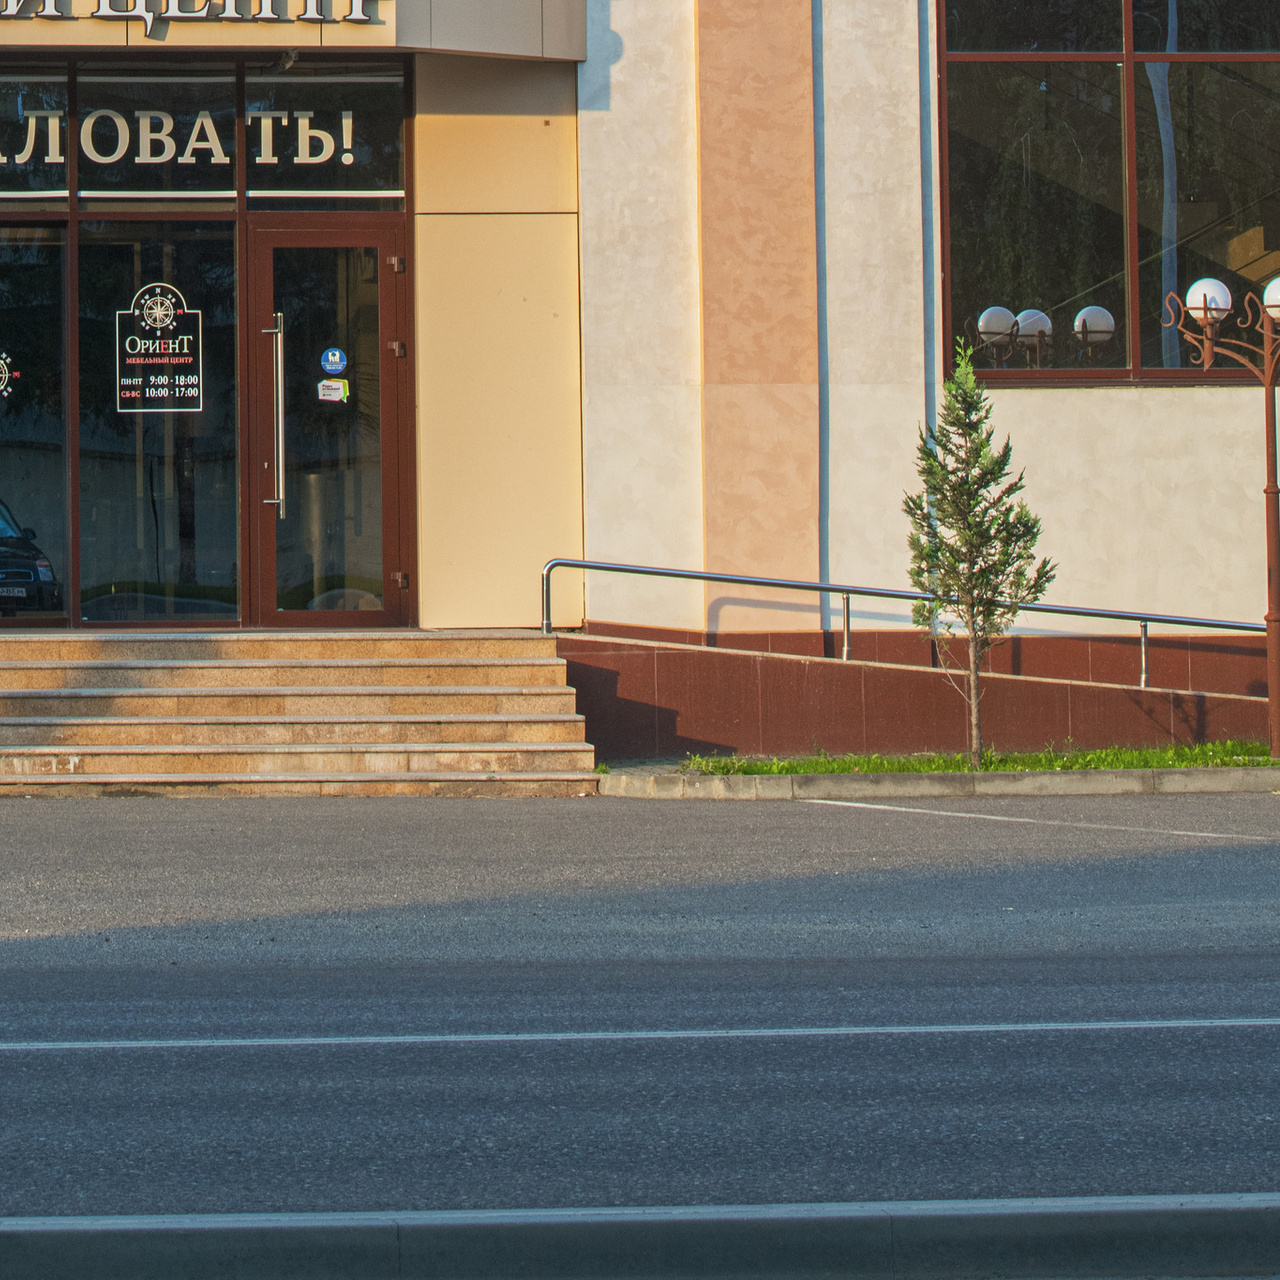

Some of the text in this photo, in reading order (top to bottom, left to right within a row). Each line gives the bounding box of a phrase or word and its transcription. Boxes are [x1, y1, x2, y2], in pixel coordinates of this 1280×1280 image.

[126, 356, 193, 365] МЕБЕЛЬНЫЙ ЦЕНТР
[150, 375, 168, 385] 9:00
[175, 375, 198, 385] 18:00
[145, 388, 168, 397] 10:00
[176, 388, 198, 397] 17:00
